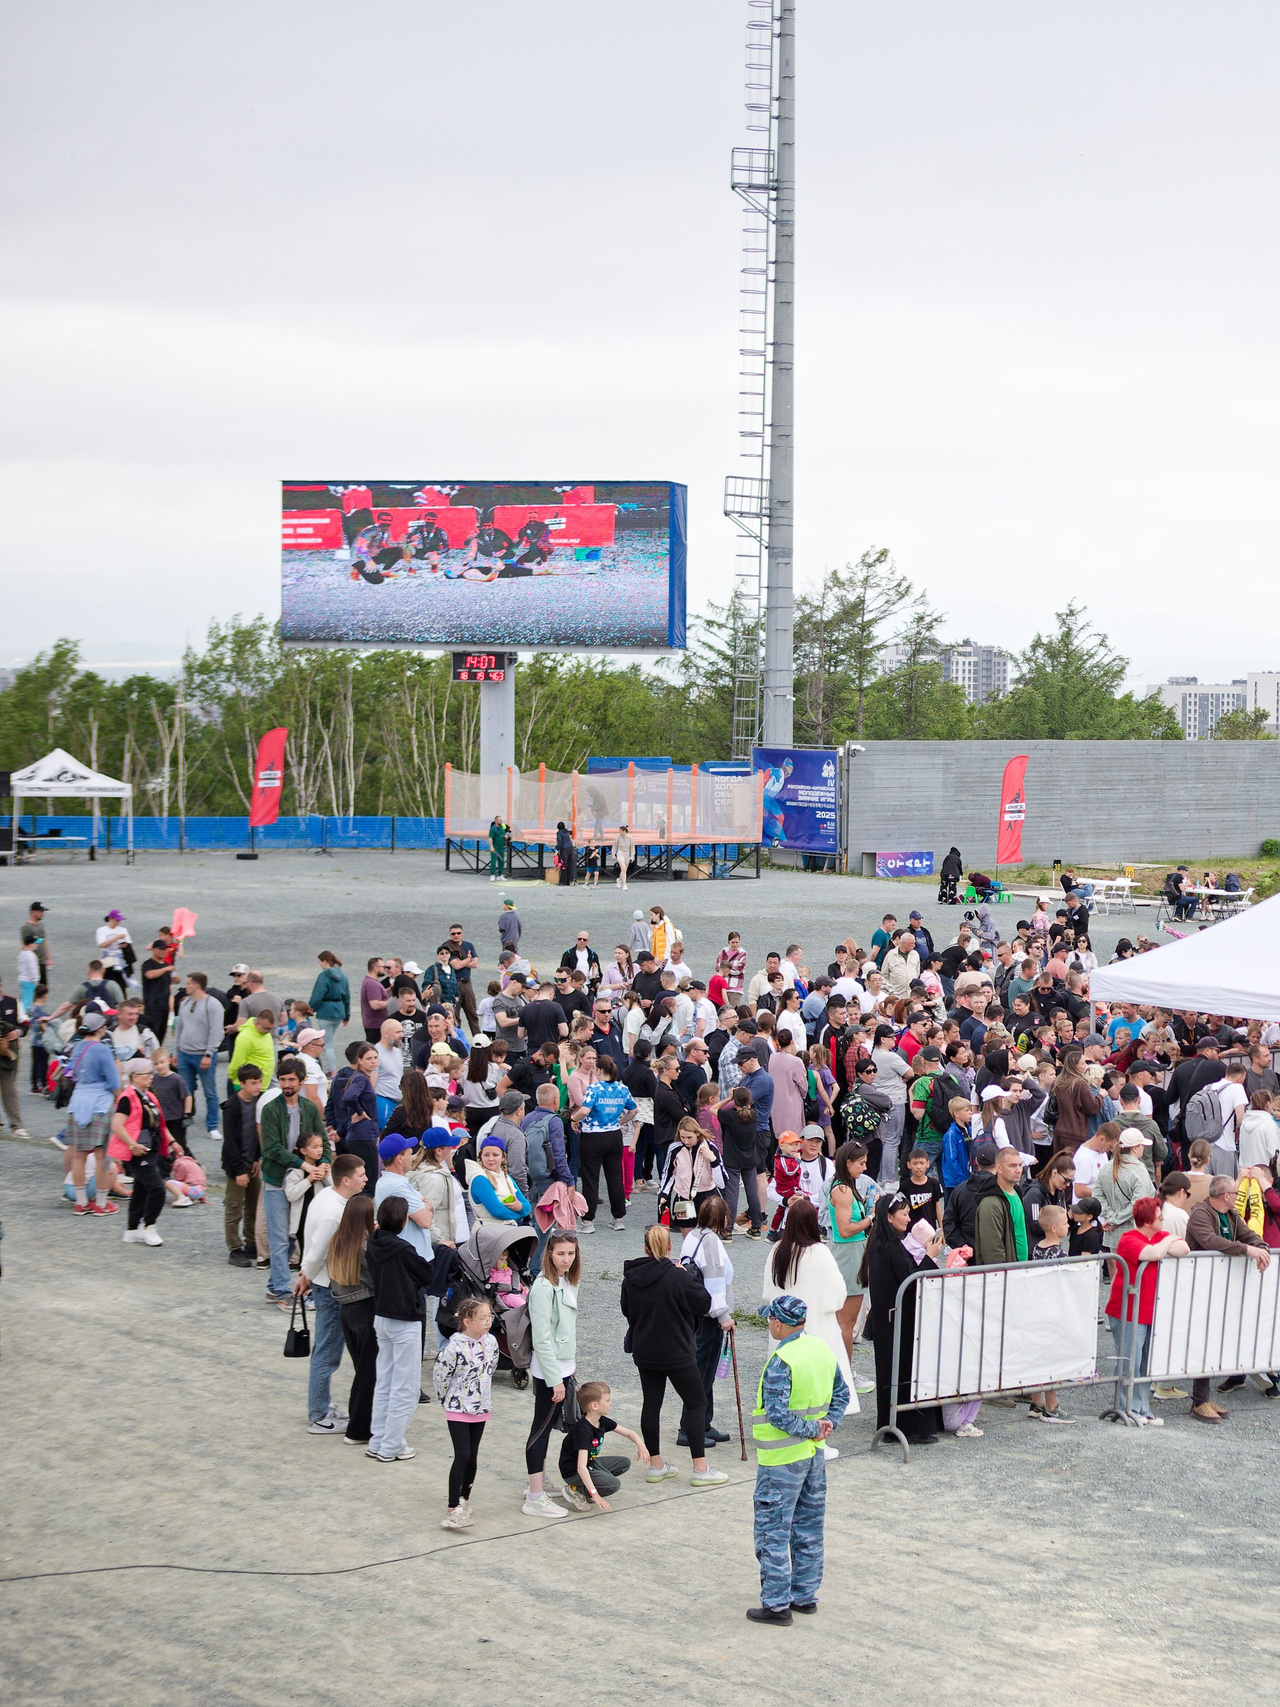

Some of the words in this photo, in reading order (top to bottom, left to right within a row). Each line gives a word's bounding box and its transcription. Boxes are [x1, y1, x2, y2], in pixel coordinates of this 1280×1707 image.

[465, 655, 496, 669] 14:07
[459, 671, 469, 681] 18
[476, 671, 486, 681] 19
[827, 779, 836, 787] IV
[815, 810, 836, 820] 2025
[887, 858, 931, 869] СТАРТ
